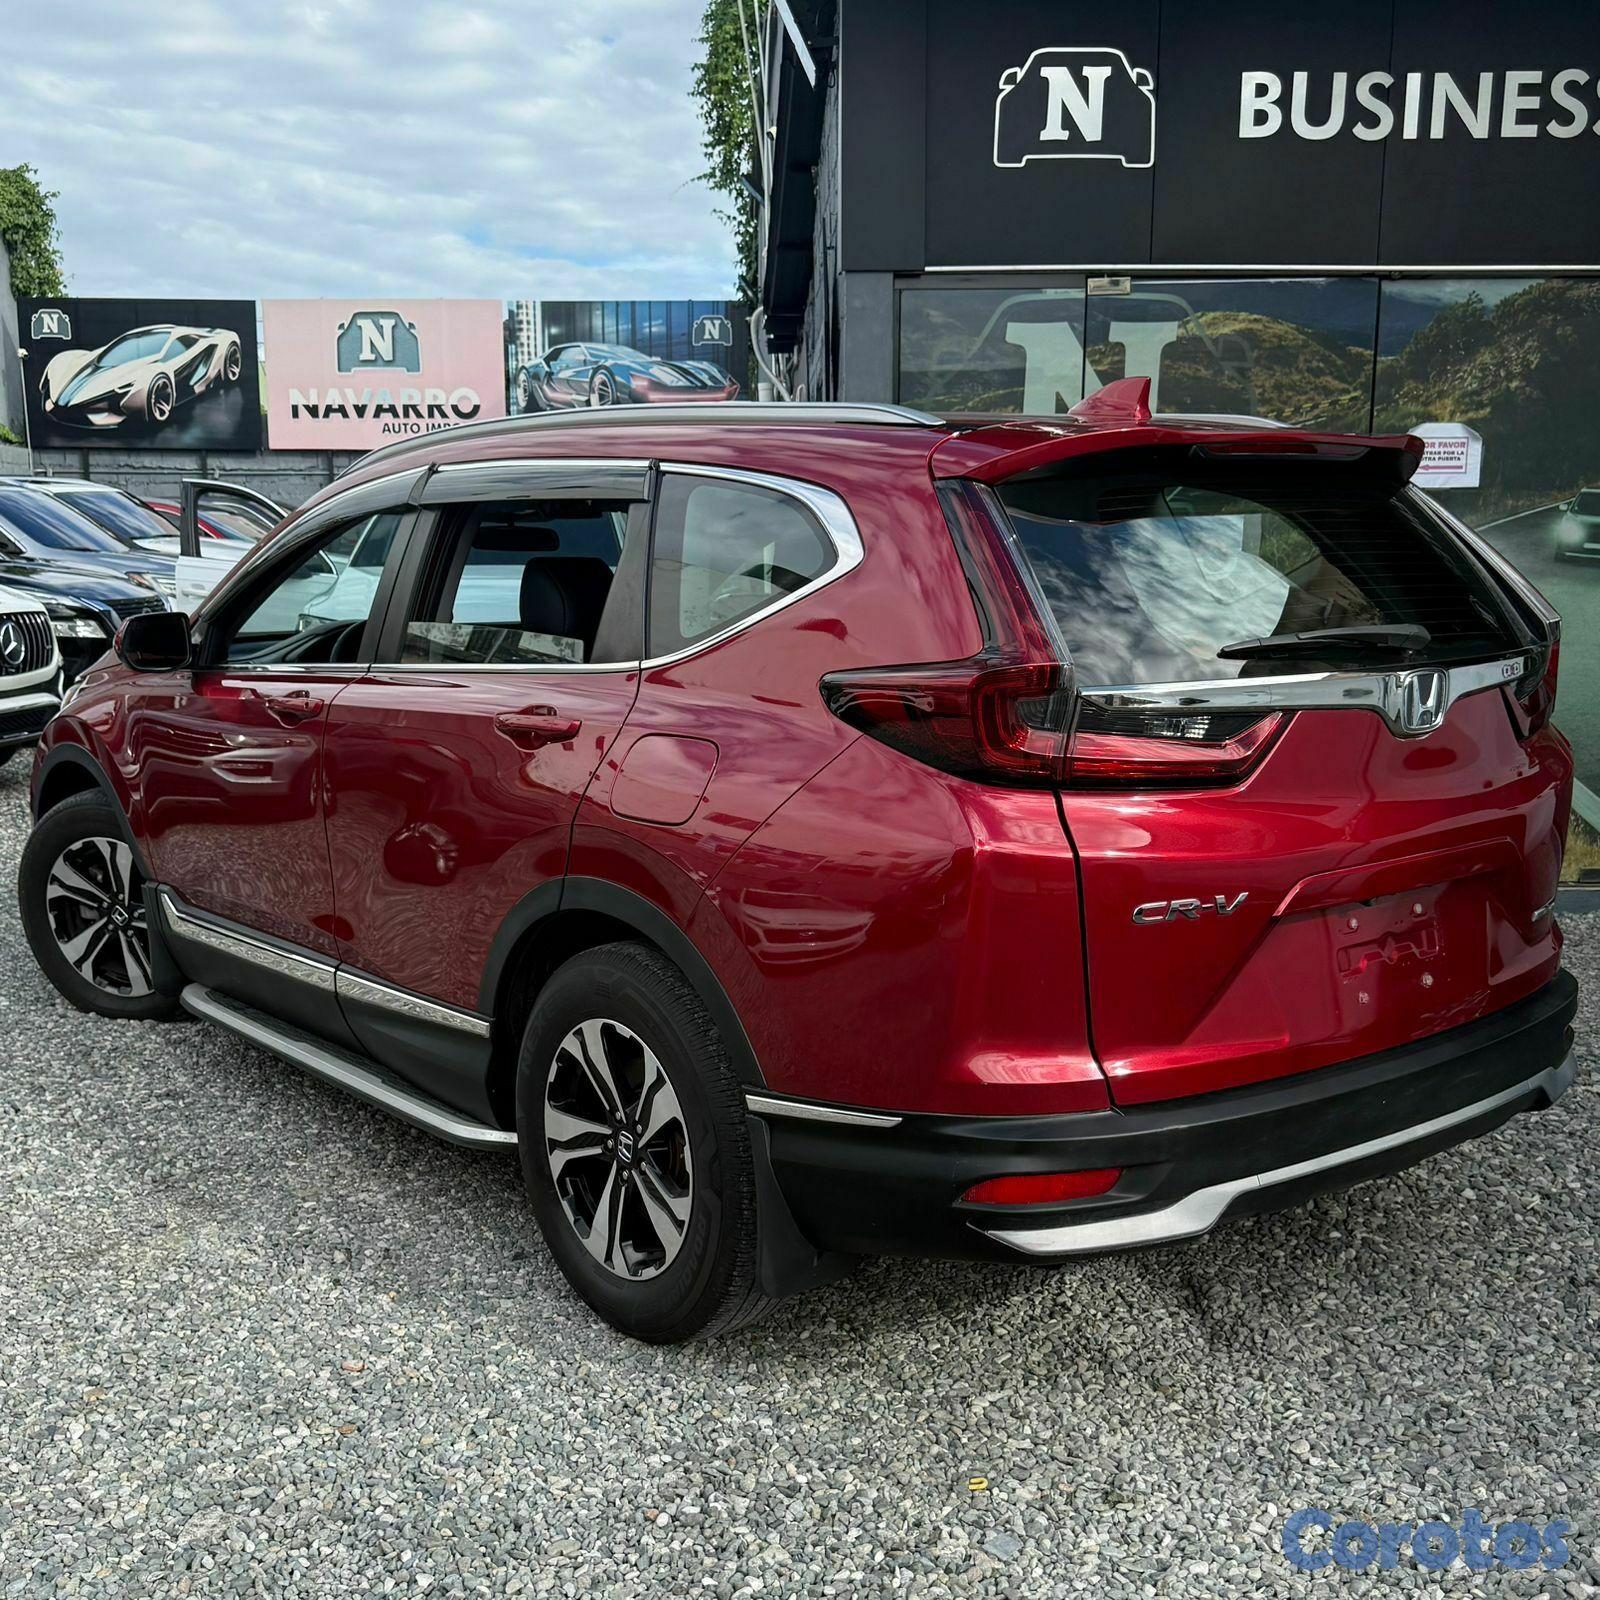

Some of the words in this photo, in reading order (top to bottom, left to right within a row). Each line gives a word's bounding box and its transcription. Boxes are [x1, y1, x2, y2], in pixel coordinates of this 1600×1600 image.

[1039, 65, 1112, 142] N
[1239, 68, 1600, 142] BUSINES
[41, 313, 59, 333] N
[703, 319, 721, 339] N
[357, 318, 395, 362] N
[288, 387, 481, 420] NAVARRO
[382, 423, 421, 434] AUTO
[1424, 441, 1436, 449] OR
[1438, 441, 1466, 449] FAVOR
[1133, 892, 1249, 925] CR-V
